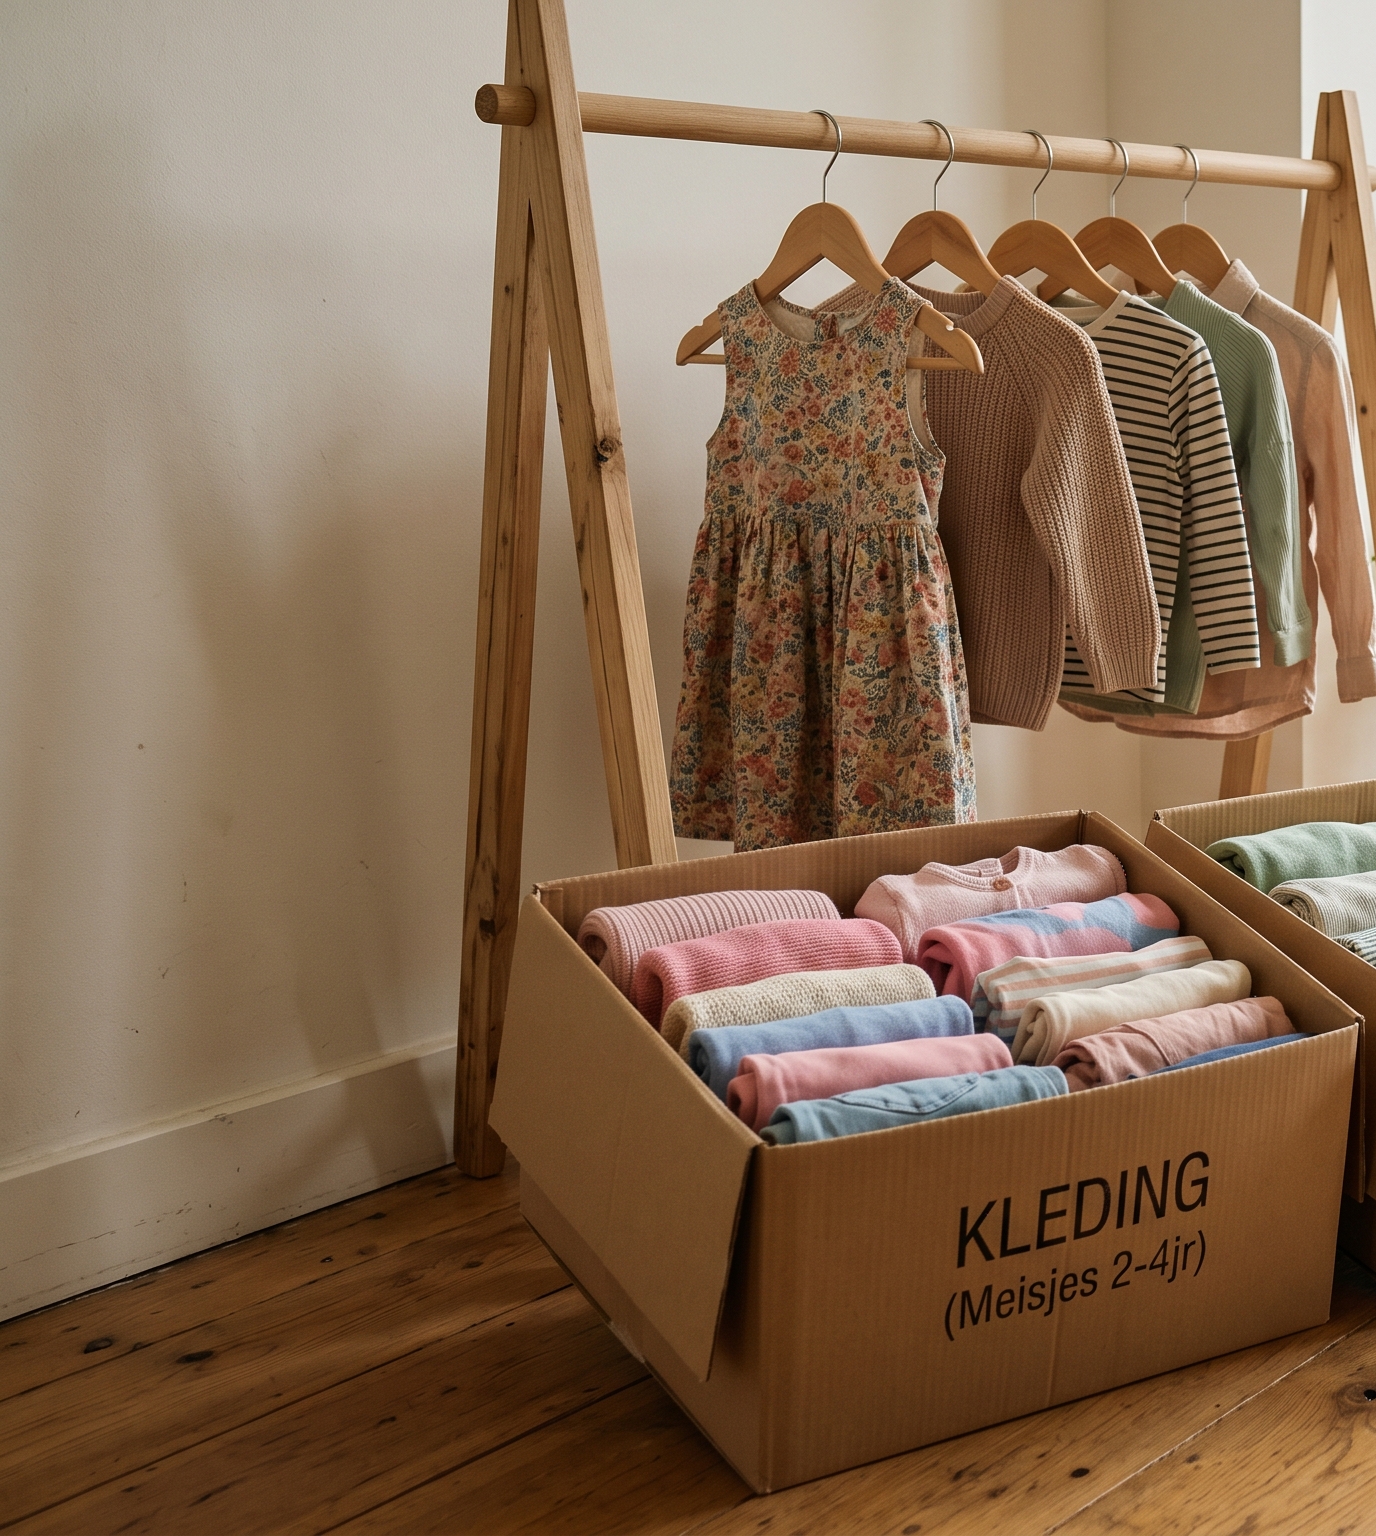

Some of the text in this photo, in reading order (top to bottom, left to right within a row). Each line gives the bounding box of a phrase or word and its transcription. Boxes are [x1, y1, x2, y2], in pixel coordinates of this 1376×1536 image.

[957, 1151, 1210, 1268] KLEDING
[945, 1230, 1206, 1342] (Meisjes 2-4jr)
